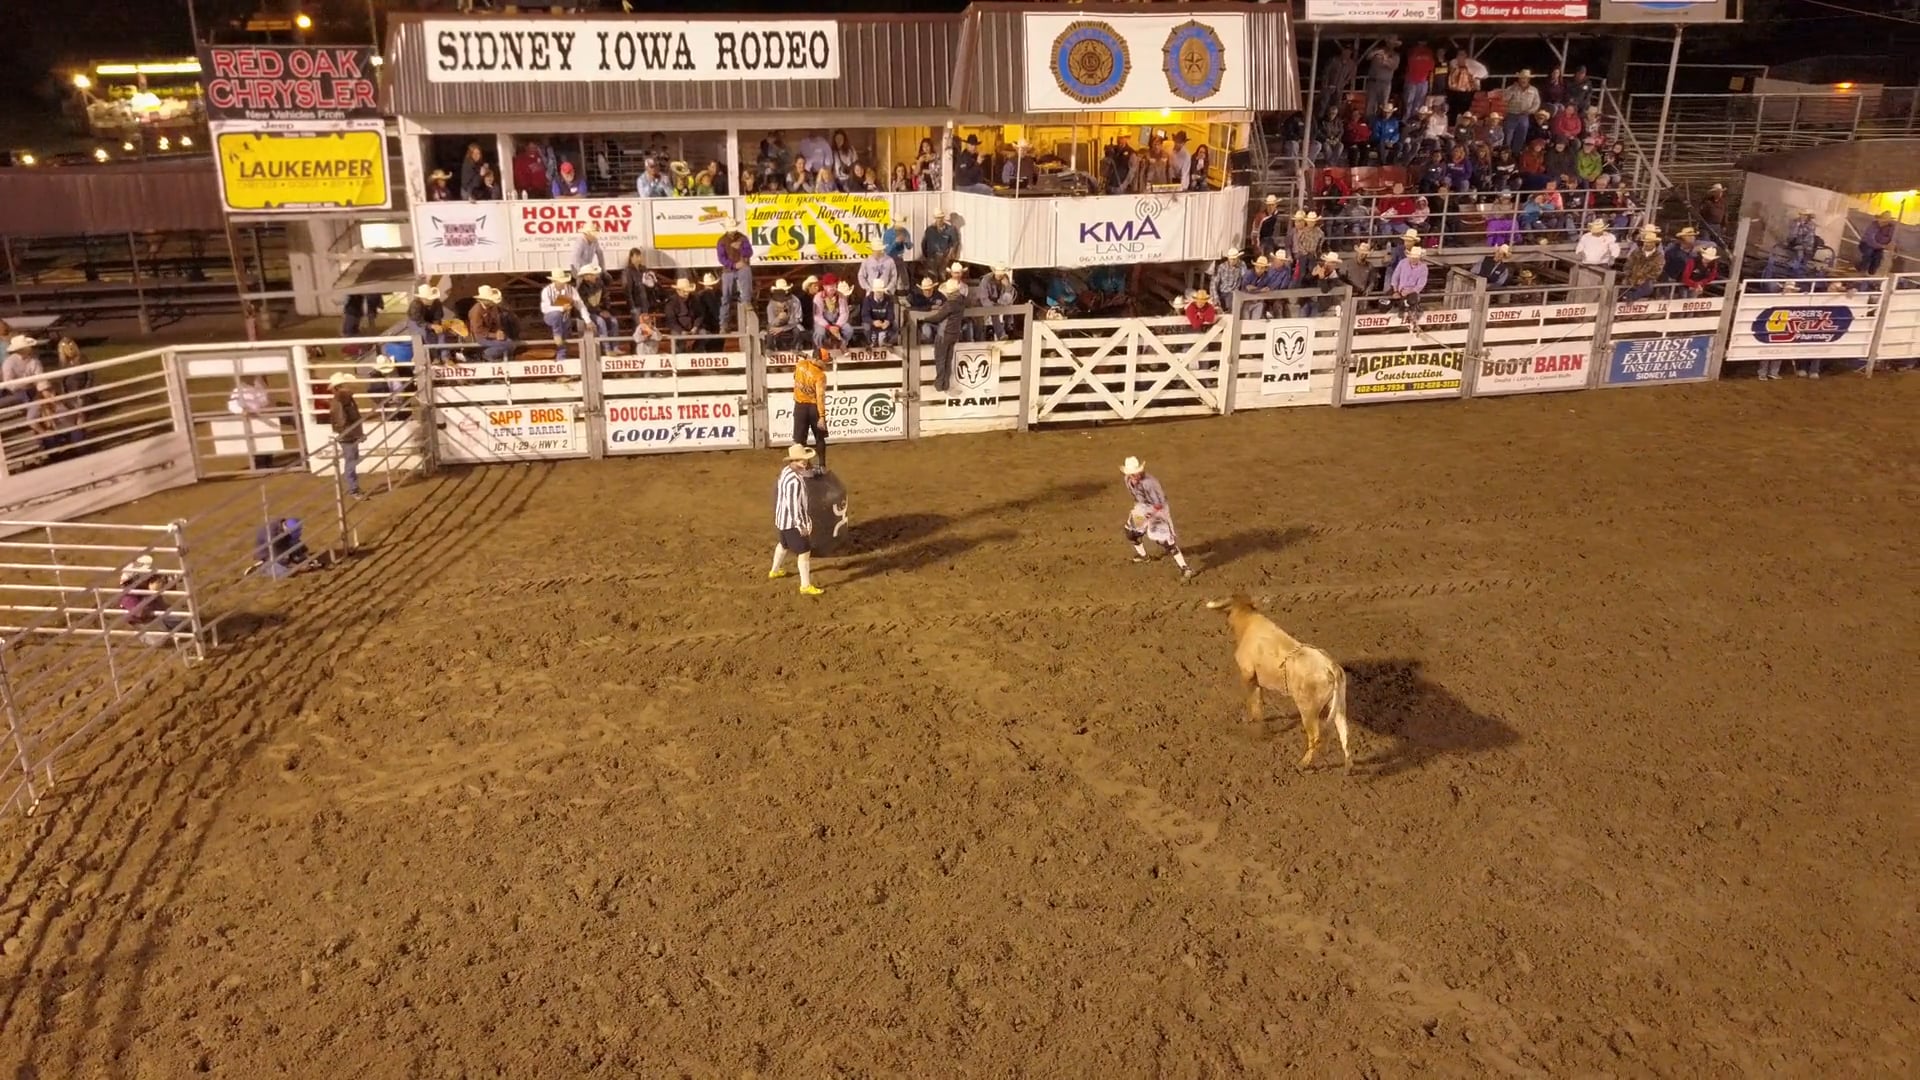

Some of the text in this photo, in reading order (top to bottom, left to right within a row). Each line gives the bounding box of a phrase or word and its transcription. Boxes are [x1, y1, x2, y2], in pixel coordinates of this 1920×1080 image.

[1402, 9, 1425, 18] Jeep
[1480, 6, 1510, 16] Sidney
[1512, 7, 1520, 15] &
[1522, 6, 1565, 15] Glenwood
[437, 30, 830, 71] SIDNEY IOWA RODEO
[211, 50, 362, 78] RED OAK
[208, 79, 376, 109] CHRYSLER
[245, 109, 345, 119] New Vehicles From
[239, 160, 374, 178] LAUKEMPER
[832, 193, 849, 203] and
[522, 205, 633, 220] HOLT GAS
[750, 204, 888, 224] Announcer Roger Mooney
[1080, 215, 1161, 243] KMA
[751, 224, 817, 251] KCSI
[1096, 242, 1145, 255] LAND
[758, 251, 870, 262] www.kcsifm.co
[1489, 307, 1586, 320] SIDNEY IA RODEO
[1617, 301, 1712, 313] SIDNEY IA RODEO
[1357, 316, 1391, 327] SIDNEY
[1426, 313, 1457, 323] RODEO
[1788, 310, 1823, 319] MOSER'S
[1793, 333, 1834, 342] Pharmacy
[1642, 338, 1694, 352] FIRST
[1621, 348, 1699, 365] EXPRESS
[605, 357, 729, 370] SIDNEY IA RODEO
[1356, 351, 1463, 378] ACHENBACH
[1481, 354, 1584, 377] BOOT BARN
[1622, 360, 1695, 373] INSURANCE
[435, 364, 564, 378] SIDNEY IA RODEO
[1263, 372, 1308, 383] RAM
[1375, 370, 1443, 381] Construction
[824, 395, 858, 406] Crop
[948, 396, 997, 407] RAM
[489, 410, 522, 425] SAPP
[530, 408, 569, 424] BROS.
[609, 403, 736, 422] DOUGLAS TIRE CO.
[493, 425, 568, 437] APPLE BARREL
[494, 442, 508, 451] JCT
[539, 440, 558, 450] HWY
[562, 440, 568, 449] 2
